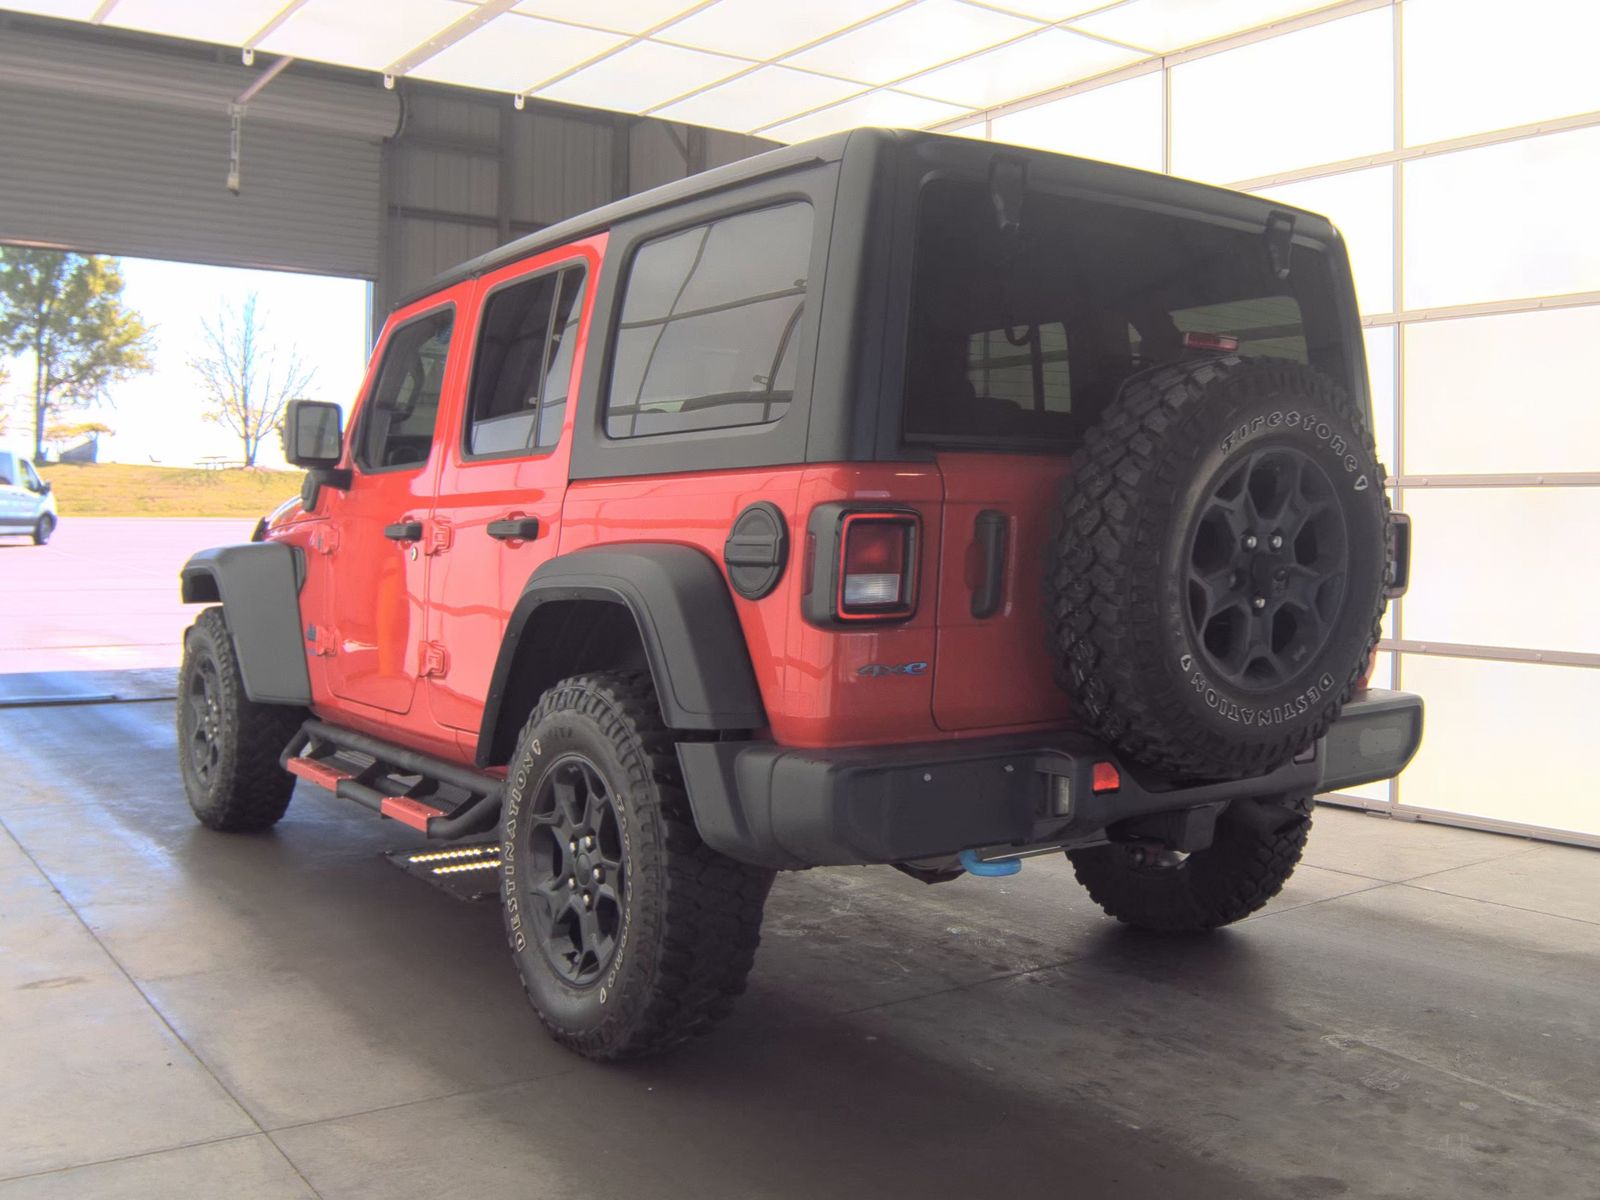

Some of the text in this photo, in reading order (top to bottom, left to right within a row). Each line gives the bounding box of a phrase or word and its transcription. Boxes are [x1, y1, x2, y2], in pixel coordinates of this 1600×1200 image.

[1220, 410, 1358, 473] Firestone
[1191, 672, 1335, 727] DESTINATION
[504, 752, 534, 952] DESTINATION
